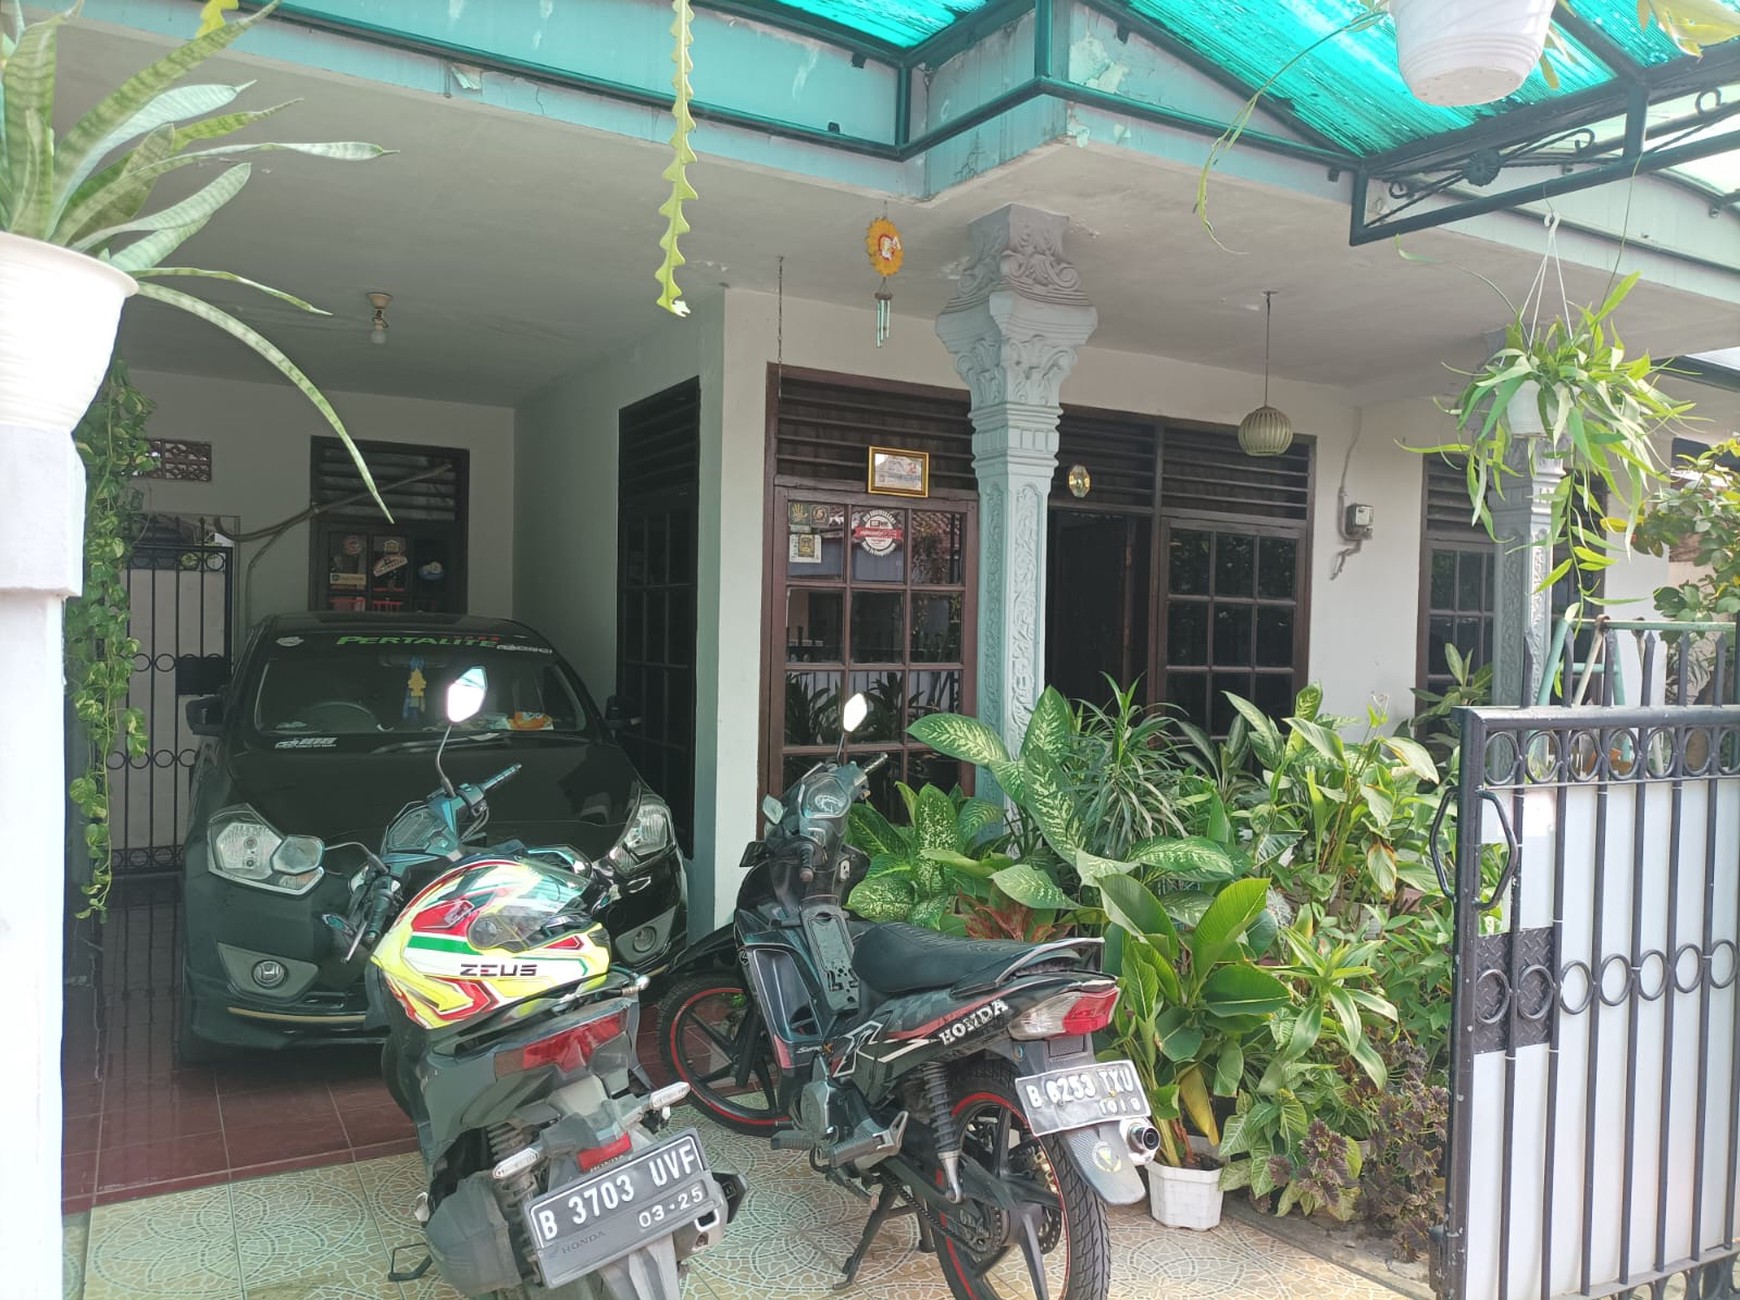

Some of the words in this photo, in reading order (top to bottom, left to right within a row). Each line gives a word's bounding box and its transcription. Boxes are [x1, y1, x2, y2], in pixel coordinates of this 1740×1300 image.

[336, 636, 498, 648] PERTALITE
[459, 963, 538, 977] ZEUS
[938, 998, 1009, 1045] HONDA
[1025, 1084, 1042, 1108] B
[1045, 1072, 1096, 1104] 6253
[538, 1209, 559, 1240] B
[567, 1174, 635, 1224] 3703
[648, 1144, 696, 1187] UVF
[560, 1230, 606, 1254] HONDA
